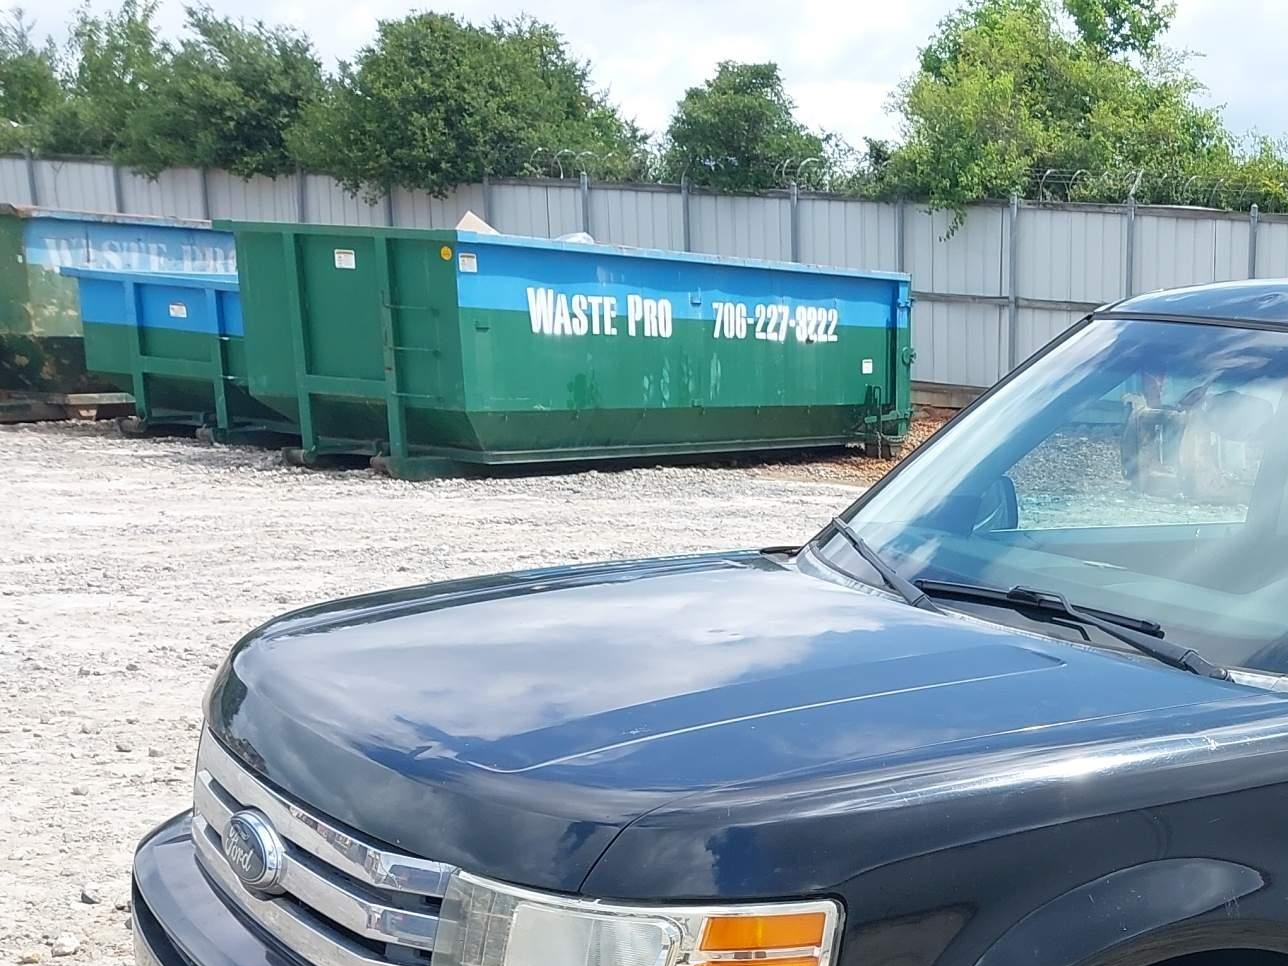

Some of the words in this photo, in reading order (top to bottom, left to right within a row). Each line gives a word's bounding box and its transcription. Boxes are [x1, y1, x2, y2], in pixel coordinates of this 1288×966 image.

[526, 287, 618, 336] WASTE
[626, 293, 673, 338] PRO
[225, 824, 255, 872] Ford
